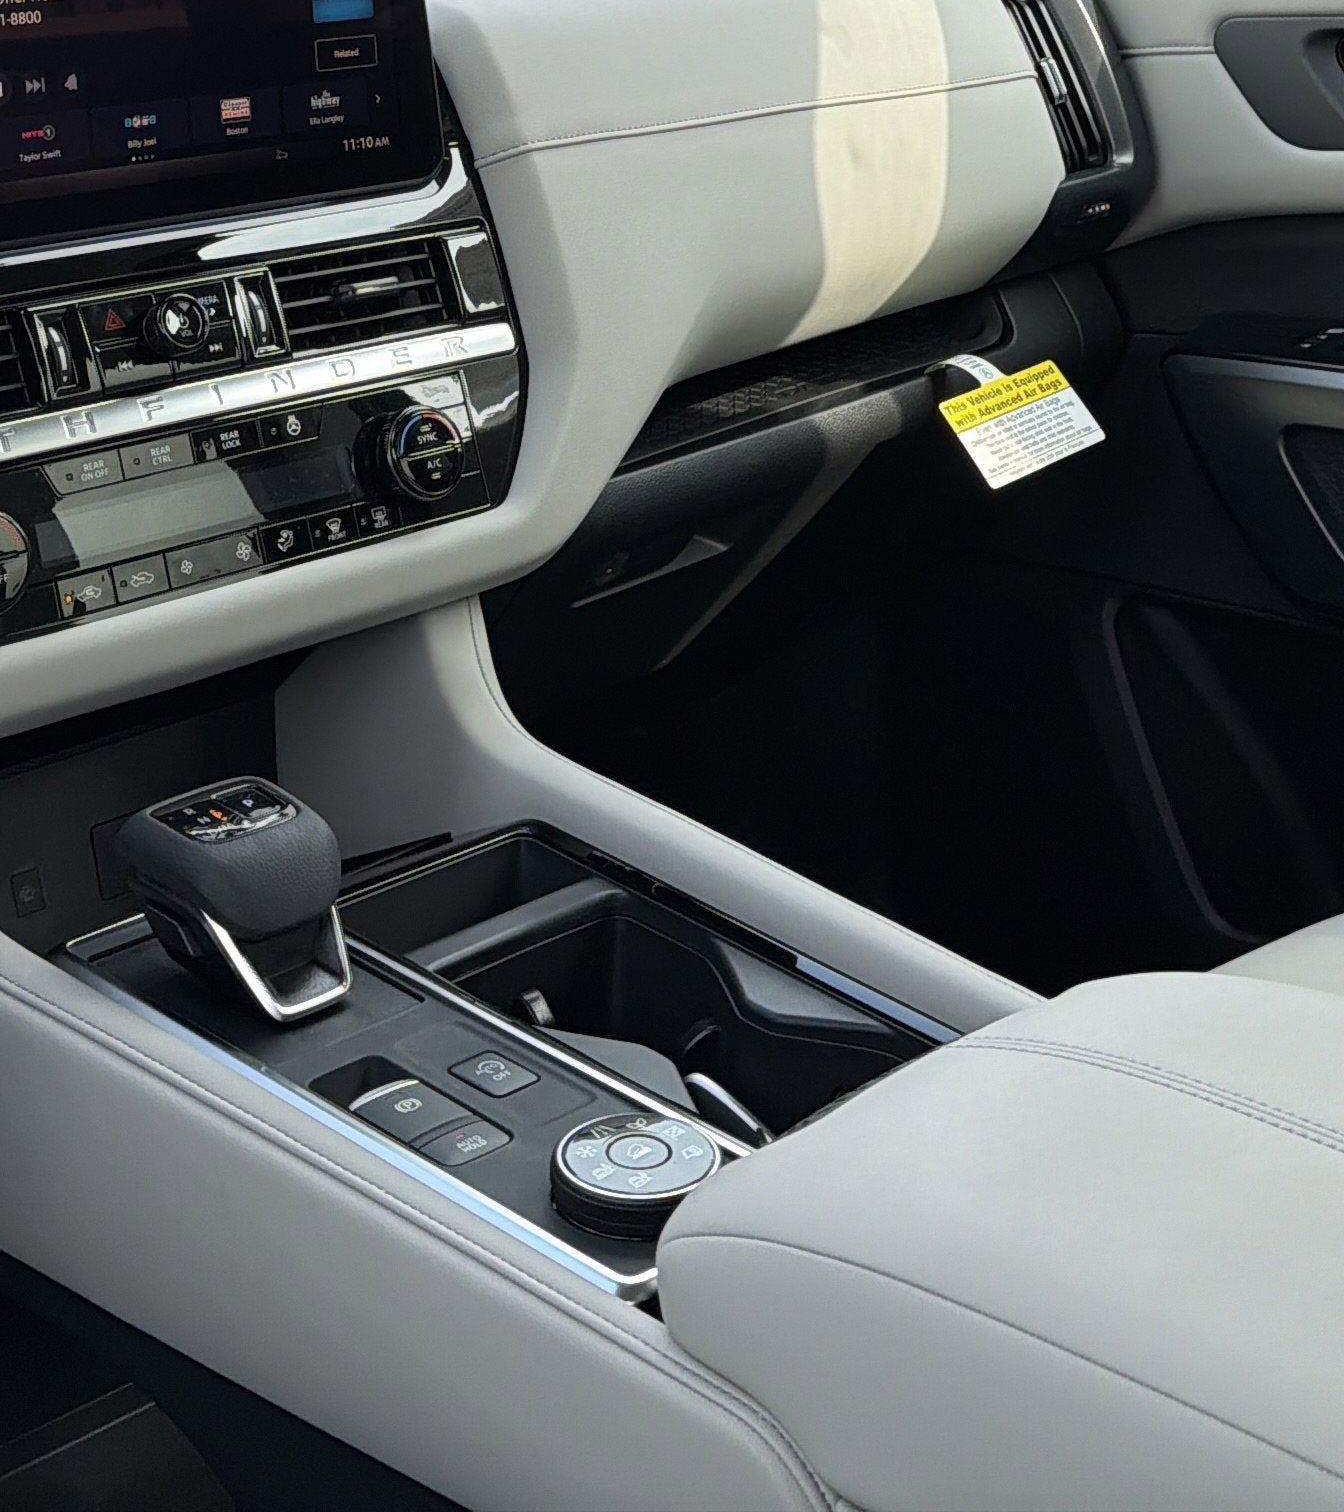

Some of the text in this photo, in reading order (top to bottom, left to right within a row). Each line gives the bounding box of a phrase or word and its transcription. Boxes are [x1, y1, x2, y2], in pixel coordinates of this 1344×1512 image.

[226, 126, 249, 136] Boston
[127, 139, 142, 149] Billy
[343, 136, 391, 151] 11:10 AM
[18, 149, 62, 163] Taylor Swift
[180, 329, 194, 338] VOL
[944, 365, 1055, 416] This Vehicle is Equipped
[954, 378, 1063, 428] with Advanced Air Bags
[220, 430, 240, 441] REAR
[417, 431, 439, 445] SYNC
[222, 438, 242, 451] LOCK
[150, 445, 171, 457] REAR
[83, 459, 105, 471] REAR
[152, 454, 173, 466] CTRL
[427, 457, 443, 469] A/C
[456, 1134, 482, 1150] AUTO
[461, 1138, 488, 1153] HOLD
